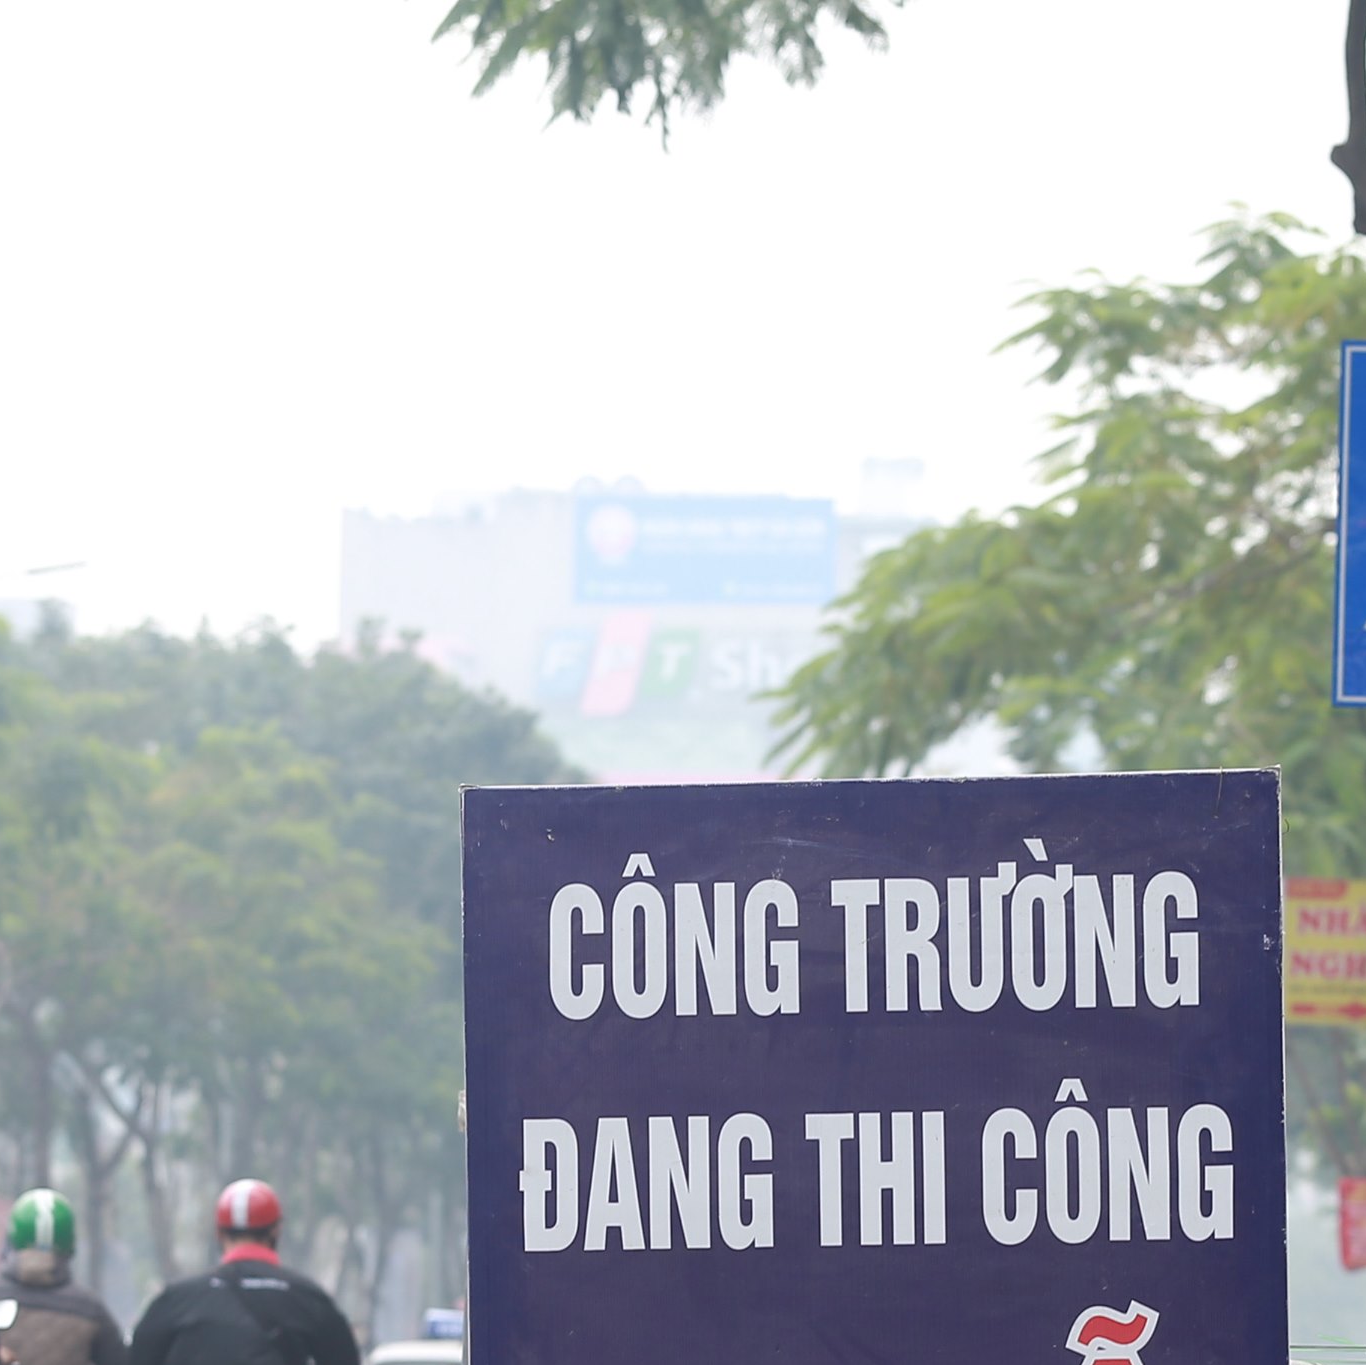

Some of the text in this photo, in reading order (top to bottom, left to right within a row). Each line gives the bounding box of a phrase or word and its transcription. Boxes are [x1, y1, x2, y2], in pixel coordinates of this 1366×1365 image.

[549, 837, 1200, 1021] CÔNG TRƯỜNG
[518, 1112, 775, 1252] ĐANG
[805, 1110, 946, 1247] THI
[981, 1077, 1235, 1247] CÔNG
